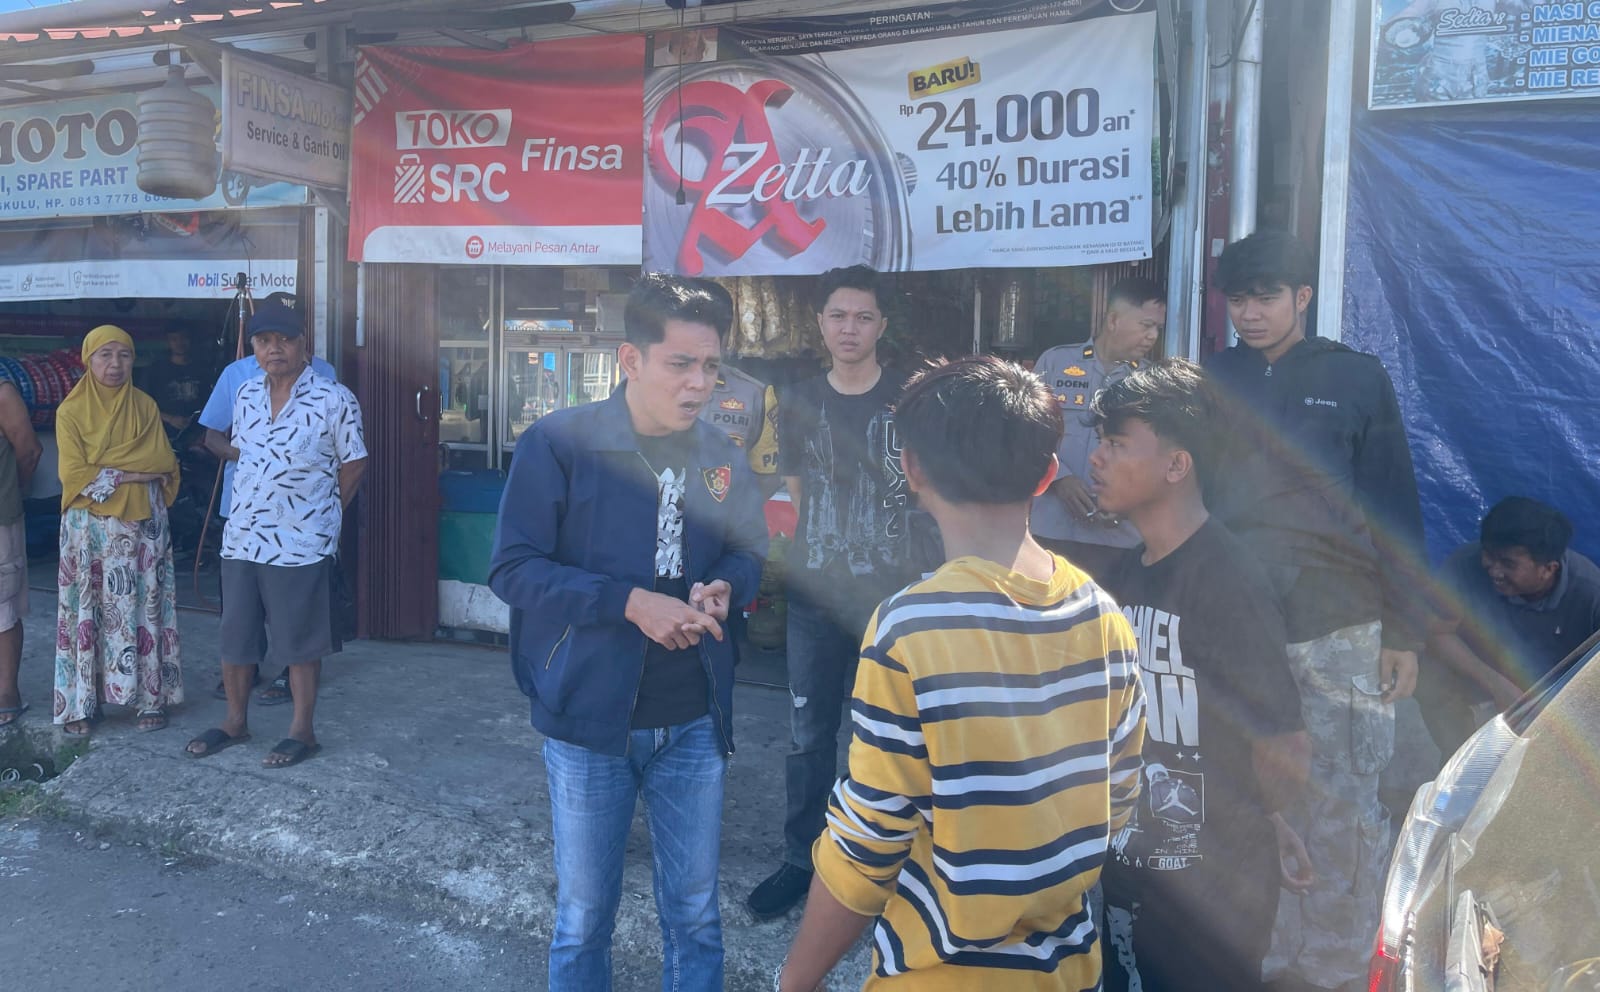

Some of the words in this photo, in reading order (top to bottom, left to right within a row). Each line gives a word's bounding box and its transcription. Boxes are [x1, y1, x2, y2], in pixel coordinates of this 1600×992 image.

[869, 10, 935, 26] PERINGATAN:
[877, 30, 901, 40] ORANG
[936, 24, 952, 32] USIA
[961, 20, 985, 29] TAHUN
[986, 17, 1002, 26] DAN
[1002, 12, 1048, 24] PEREMPUAN
[1049, 9, 1073, 18] HAMIL
[1436, 8, 1492, 30] Sedia
[1534, 3, 1583, 22] NASI
[1533, 24, 1600, 44] MIENA
[1530, 48, 1568, 67] MIE
[913, 62, 976, 92] BARU!
[1529, 70, 1567, 88] MIE
[237, 70, 306, 123] FINSA
[406, 112, 500, 147] TOKO
[900, 104, 914, 117] Rp
[916, 87, 1100, 151] 24.000
[247, 120, 289, 148] Service
[292, 131, 300, 150] &
[303, 134, 330, 157] Ganti
[521, 137, 623, 172] Finsa
[16, 170, 73, 192] SPARE
[79, 166, 128, 187] PART
[430, 161, 510, 203] SRC
[706, 141, 872, 206] Zetta
[936, 155, 1006, 192] 40%
[1017, 148, 1130, 187] Durasi
[45, 198, 64, 208] HP.
[106, 193, 138, 204] 7778
[936, 201, 1025, 235] Lebih
[488, 241, 532, 255] Melayani
[534, 241, 568, 253] Pesan
[569, 242, 601, 254] Antar
[187, 273, 219, 287] Mobil
[221, 273, 257, 288] Suer
[713, 413, 750, 427] POLRI
[1158, 857, 1188, 870] GOAT
